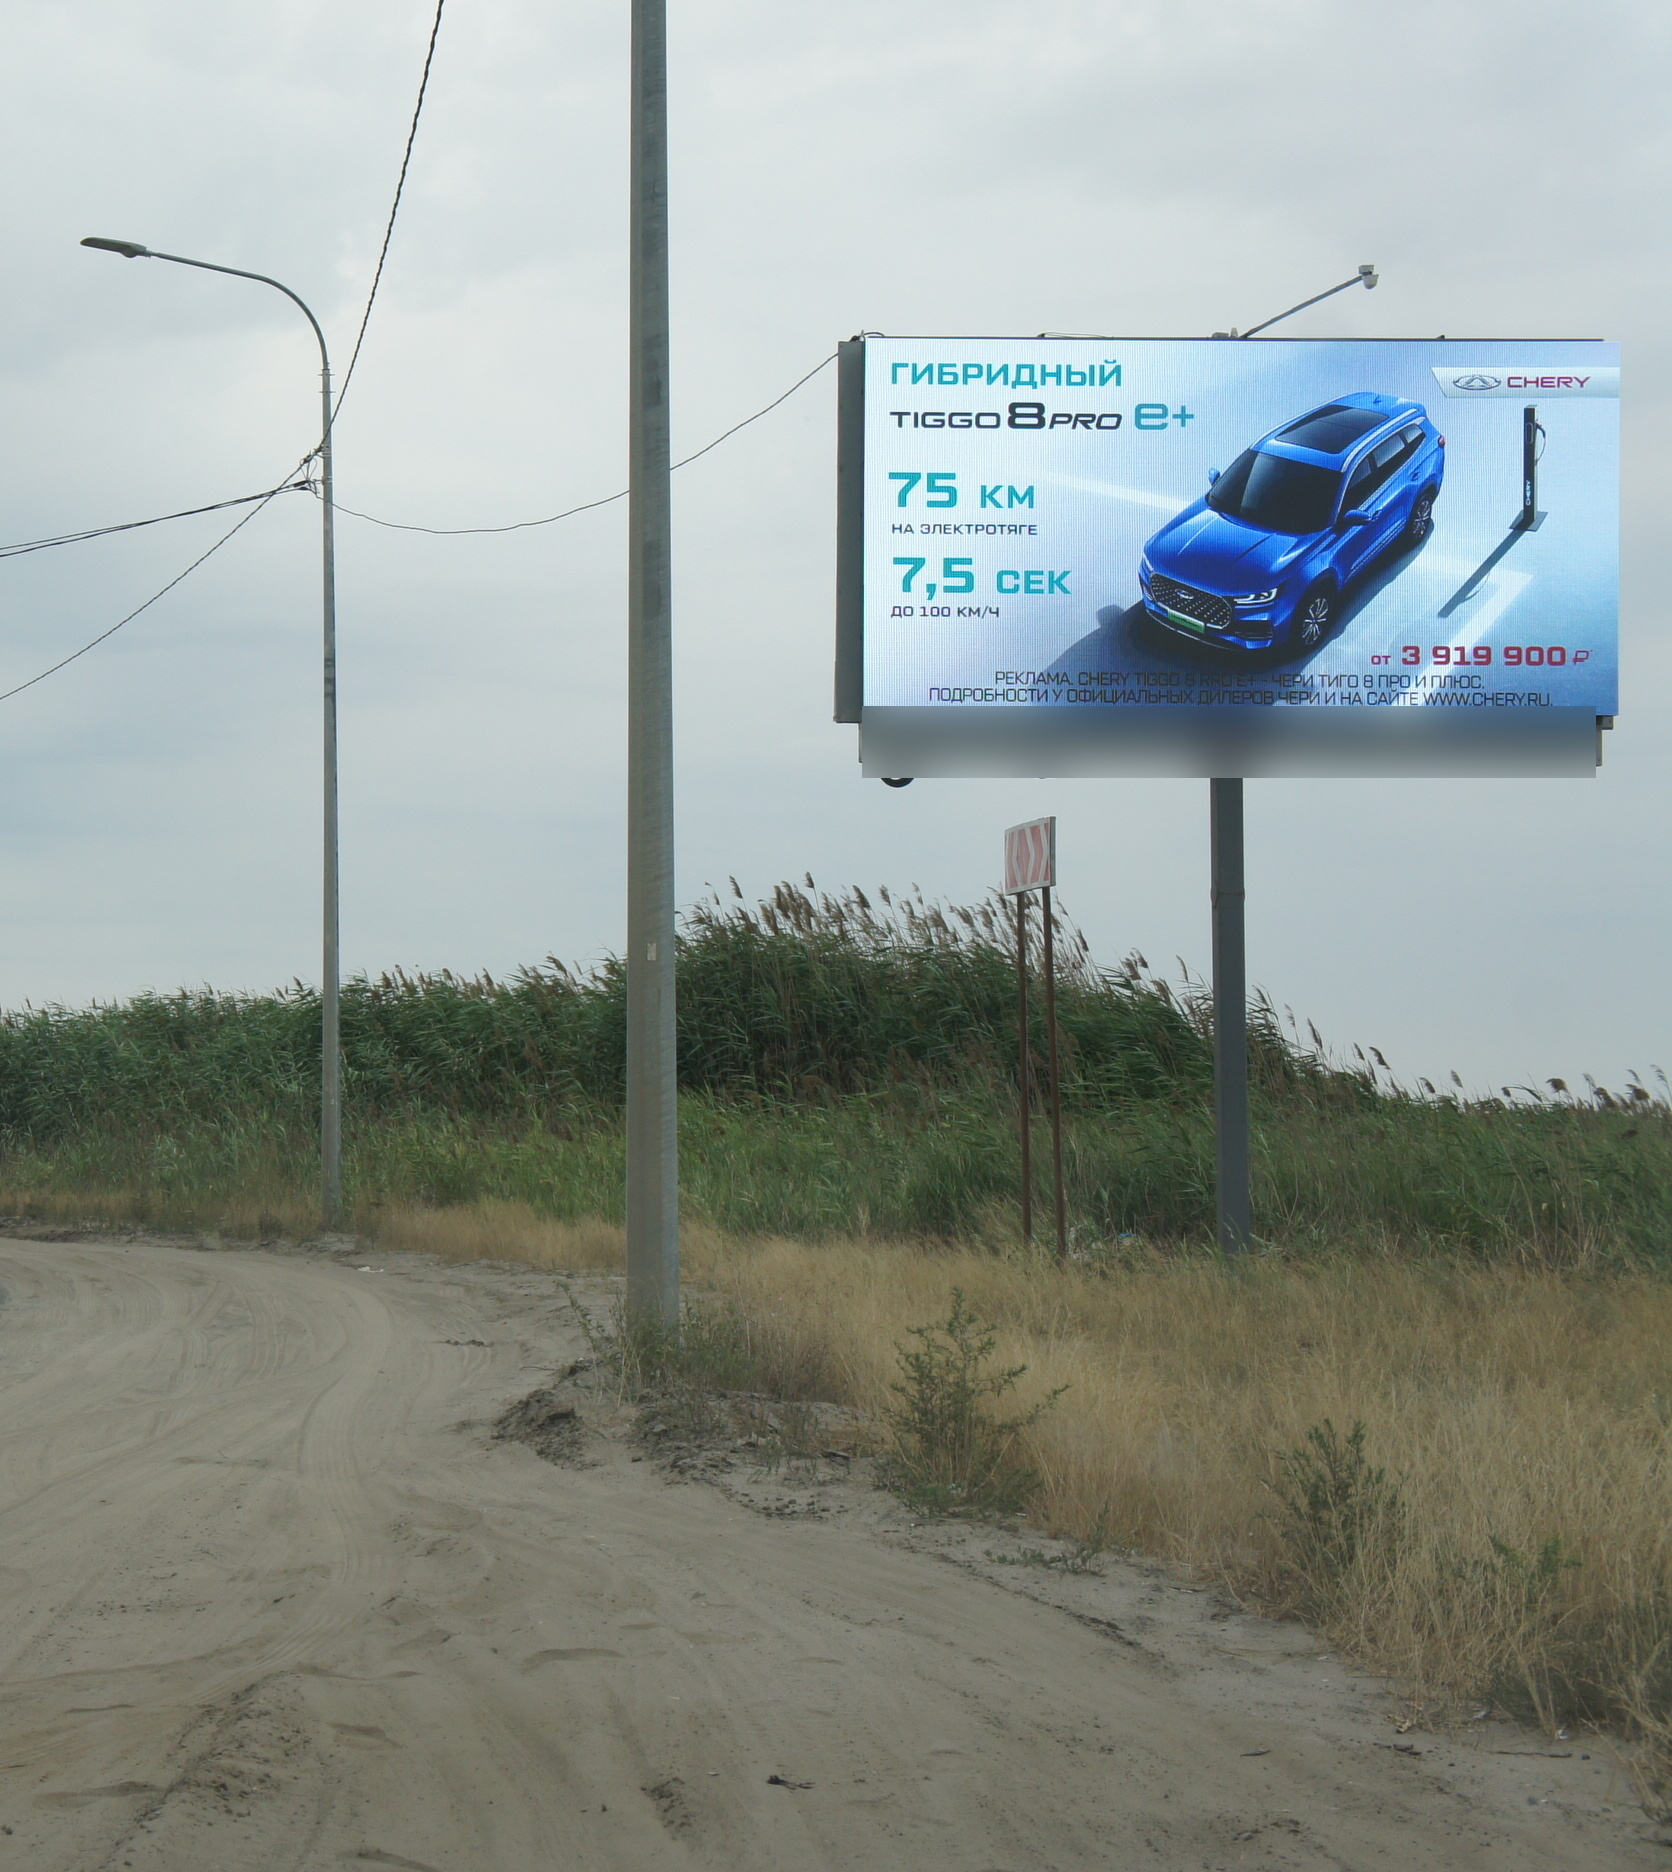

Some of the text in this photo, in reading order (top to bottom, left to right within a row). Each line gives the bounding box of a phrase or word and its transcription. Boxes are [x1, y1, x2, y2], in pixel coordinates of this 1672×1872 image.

[890, 359, 1123, 390] ГИБРИДНЫЙ
[1506, 376, 1591, 388] CHERY
[889, 411, 1001, 429] TIGGO
[1007, 402, 1046, 430] 8
[1049, 413, 1123, 430] PRO
[888, 472, 958, 509] 75
[891, 523, 1038, 536] НА ЭЛЕКТРОТЯГЕ
[892, 557, 1073, 600] 7,5 СЕК
[890, 605, 1000, 619] ДО 100 КМ/Ч
[1401, 645, 1421, 666] 3
[1432, 645, 1493, 667] 919
[995, 671, 1073, 686] РЕКЛАМА.
[1078, 672, 1129, 686] CHERY
[1135, 672, 1179, 687] TIGGO
[1272, 674, 1315, 688] ЧЕРИ
[1318, 674, 1359, 689] ТИГО
[1363, 674, 1374, 689] 8
[1379, 674, 1411, 689] ПРО
[1415, 674, 1427, 689] И
[1431, 674, 1485, 689] ПЛЮС.
[929, 688, 1554, 707] ПОДРОБНОСТИ У ОФИЦИАЛЬНЫХ ДИЛЕРОВ ЧЕРИ И НА САЙТЕ WWW.CHERY.RU.
